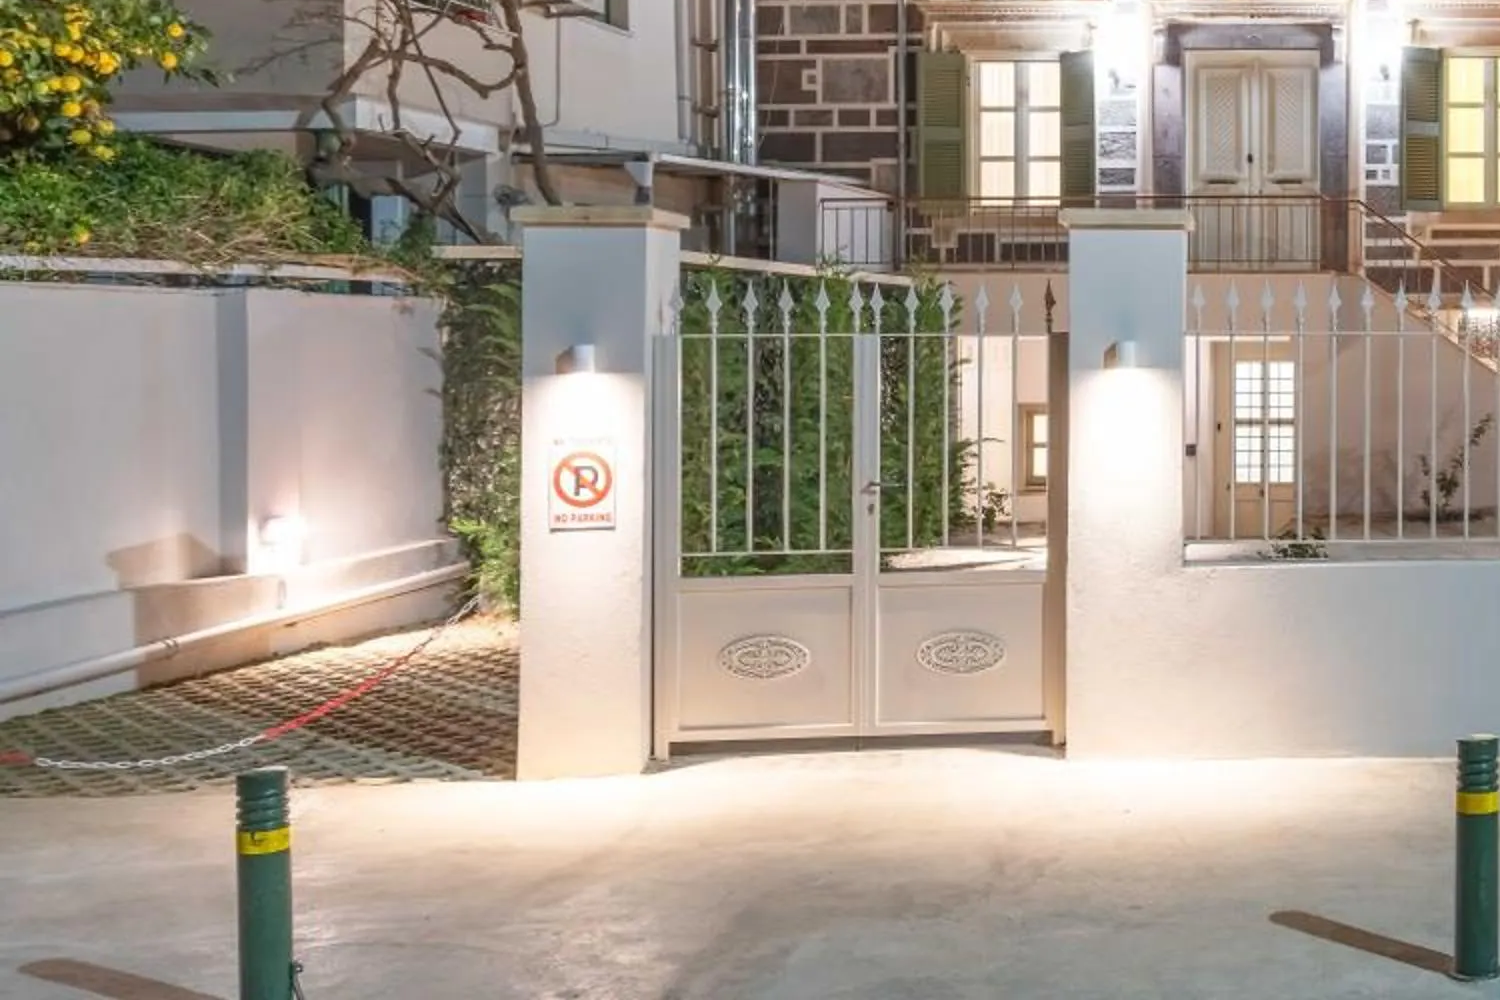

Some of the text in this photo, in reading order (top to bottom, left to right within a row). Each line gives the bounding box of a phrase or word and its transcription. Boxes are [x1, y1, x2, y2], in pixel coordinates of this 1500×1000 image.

[574, 466, 598, 496] P
[554, 512, 612, 523] NO PARKING
